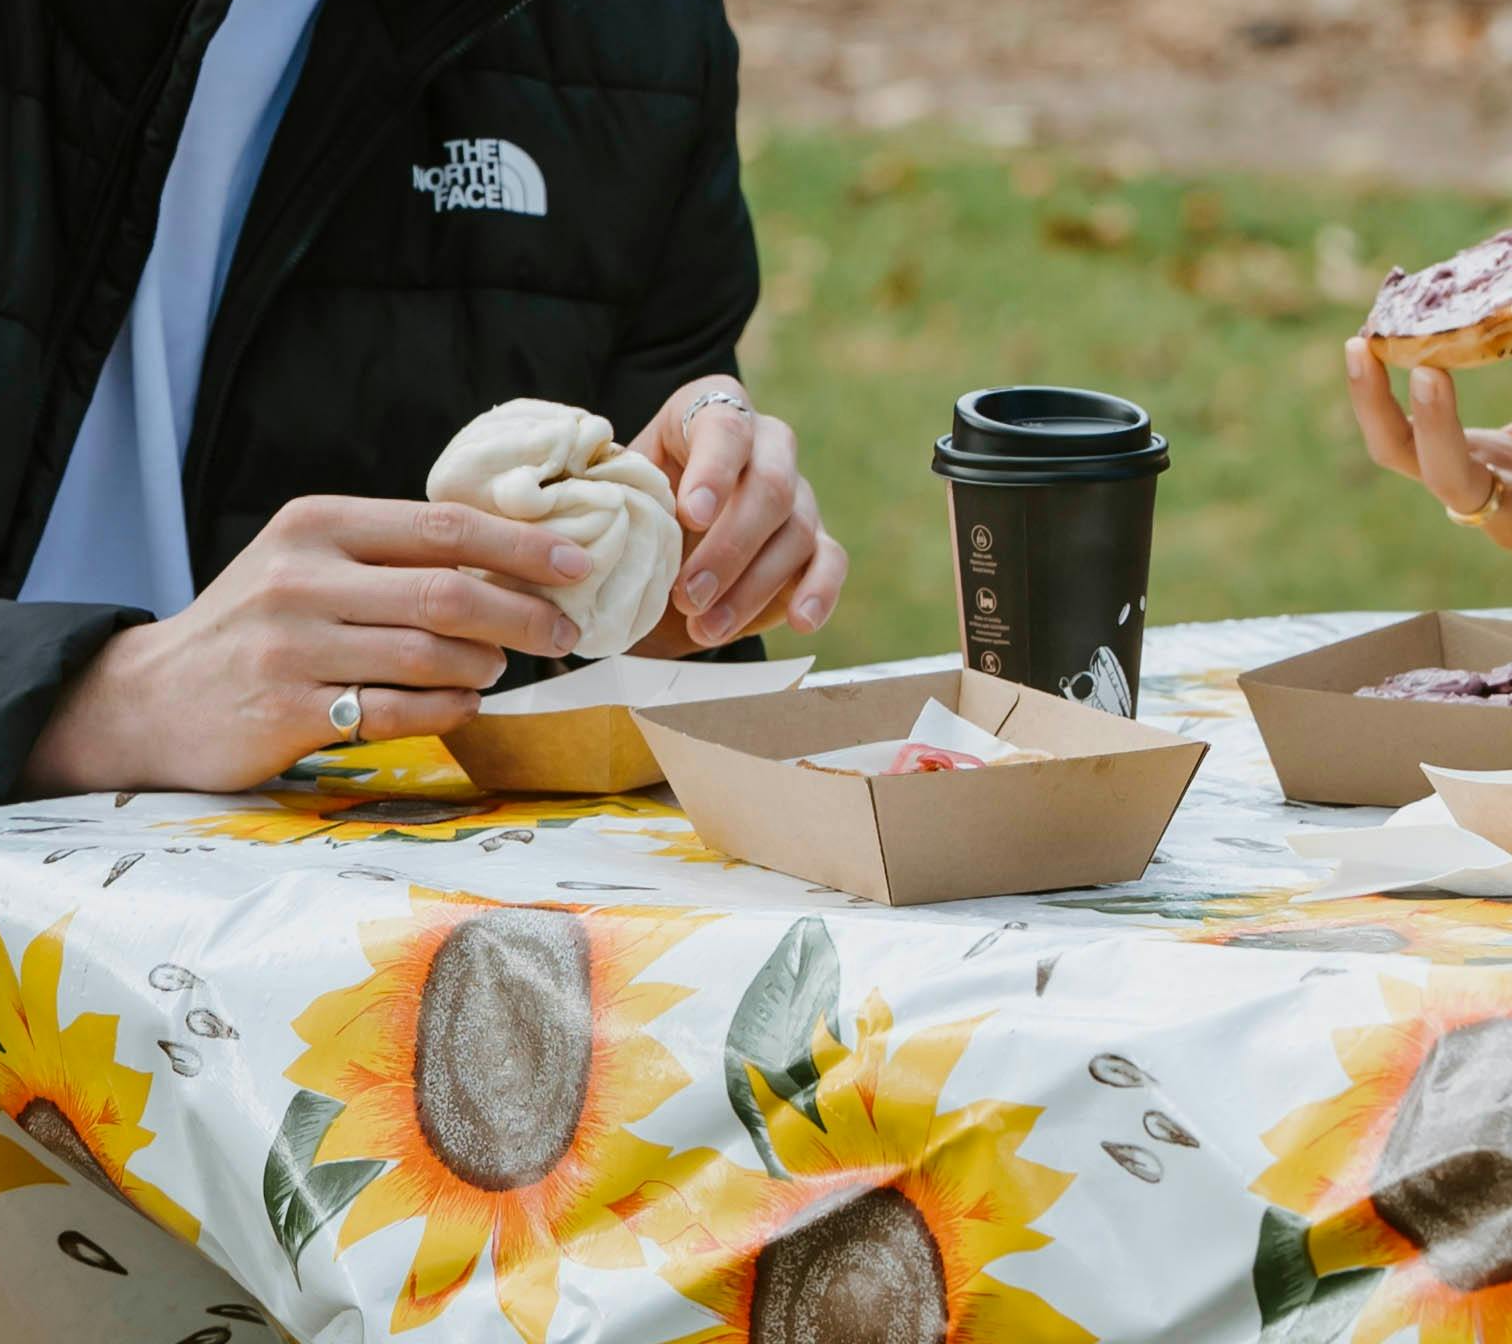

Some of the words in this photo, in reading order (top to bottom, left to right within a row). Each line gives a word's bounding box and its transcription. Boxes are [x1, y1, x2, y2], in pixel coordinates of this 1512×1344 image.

[443, 138, 499, 163] THE
[412, 161, 500, 192] NORTH
[434, 183, 502, 213] FACE
